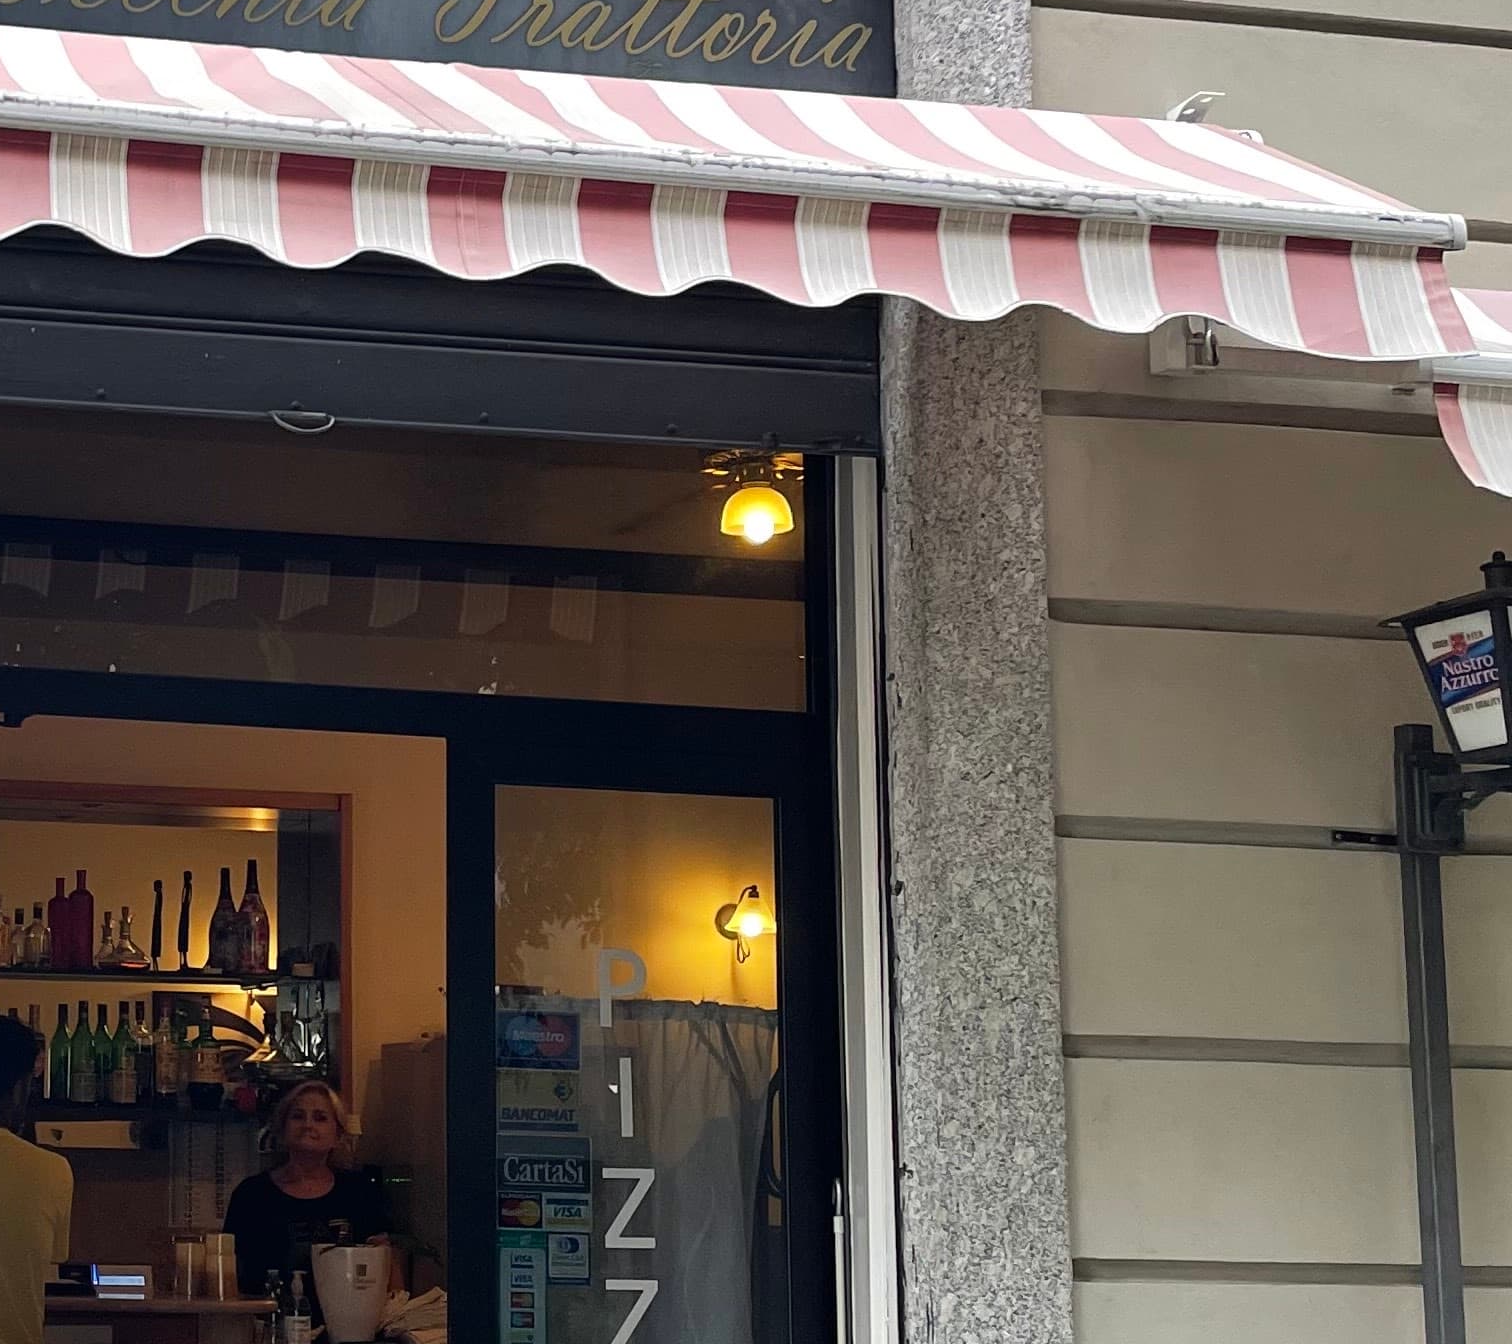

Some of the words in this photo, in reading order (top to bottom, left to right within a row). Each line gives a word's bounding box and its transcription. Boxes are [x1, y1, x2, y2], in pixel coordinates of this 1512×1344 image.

[1443, 654, 1494, 677] Nastro
[1441, 668, 1499, 692] Azzurro
[511, 1029, 565, 1043] Maestro
[500, 1106, 577, 1122] BANCOMAT
[552, 1205, 583, 1218] VISA
